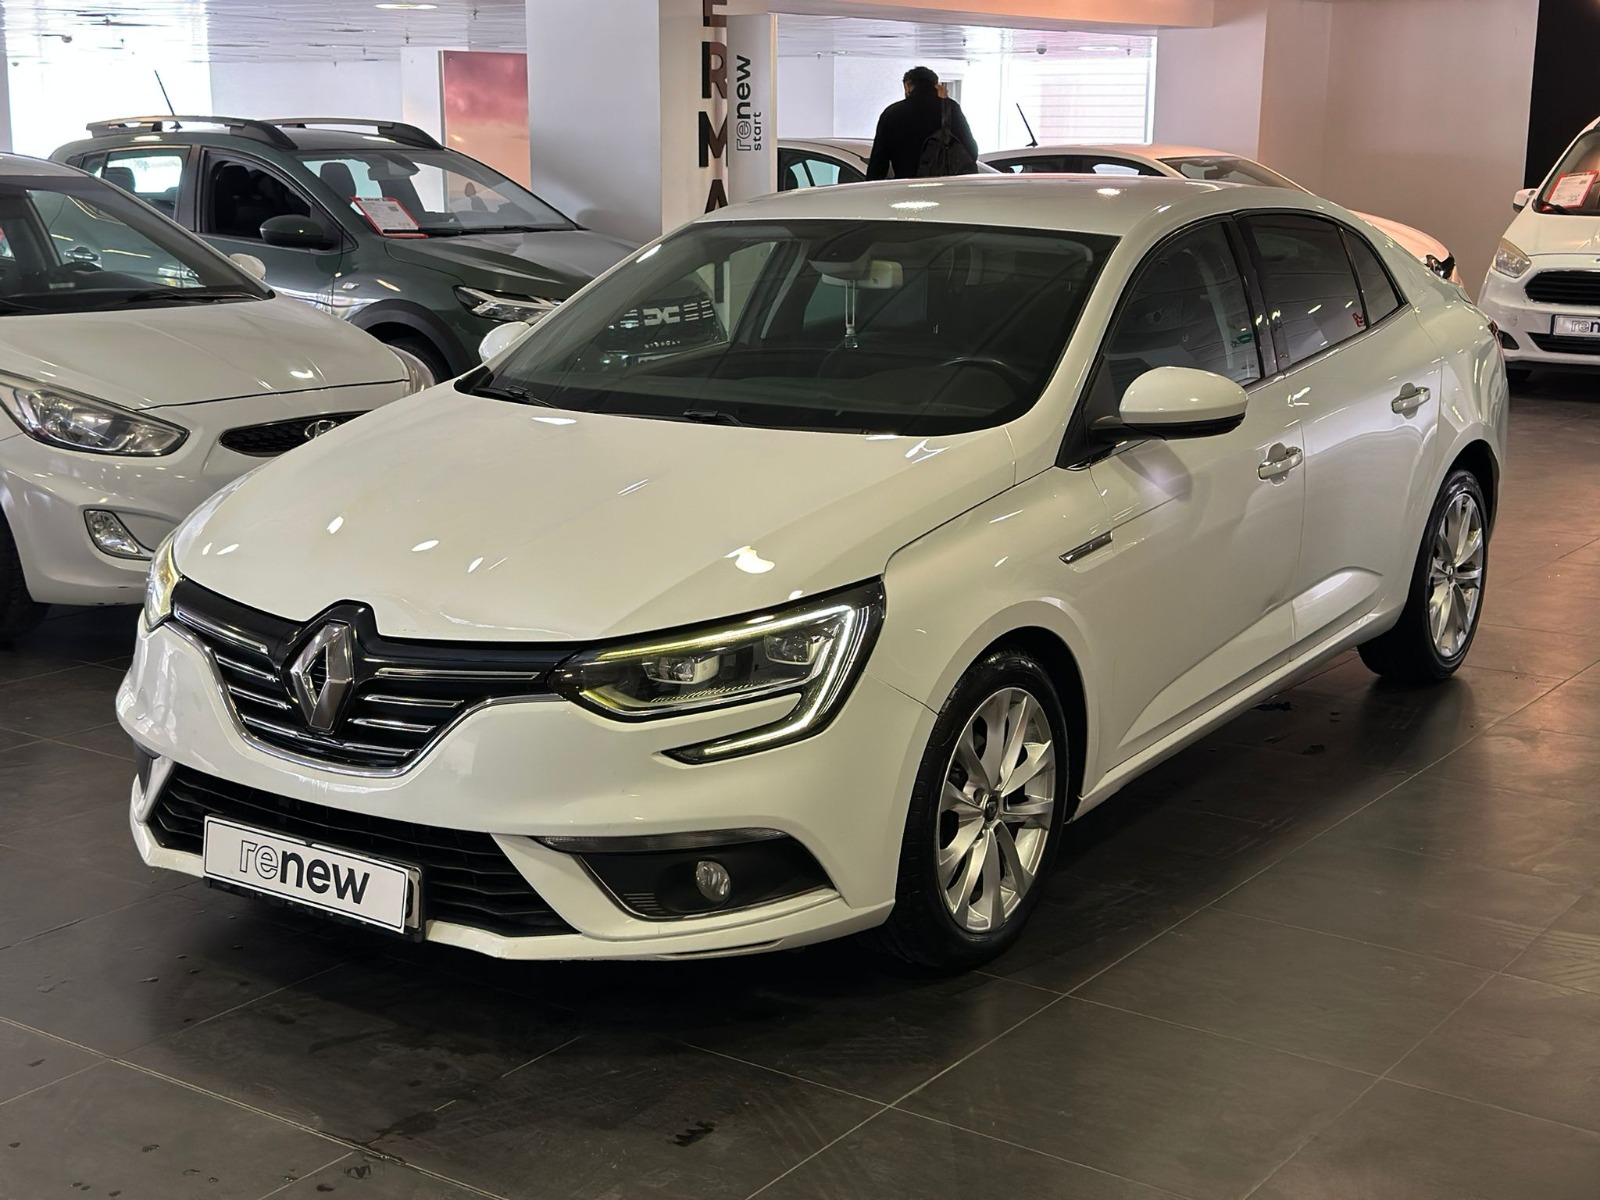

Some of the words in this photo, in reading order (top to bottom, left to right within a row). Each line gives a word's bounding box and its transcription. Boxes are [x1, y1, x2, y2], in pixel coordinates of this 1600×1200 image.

[736, 54, 751, 152] renew
[753, 111, 762, 151] start
[239, 839, 370, 905] renew
